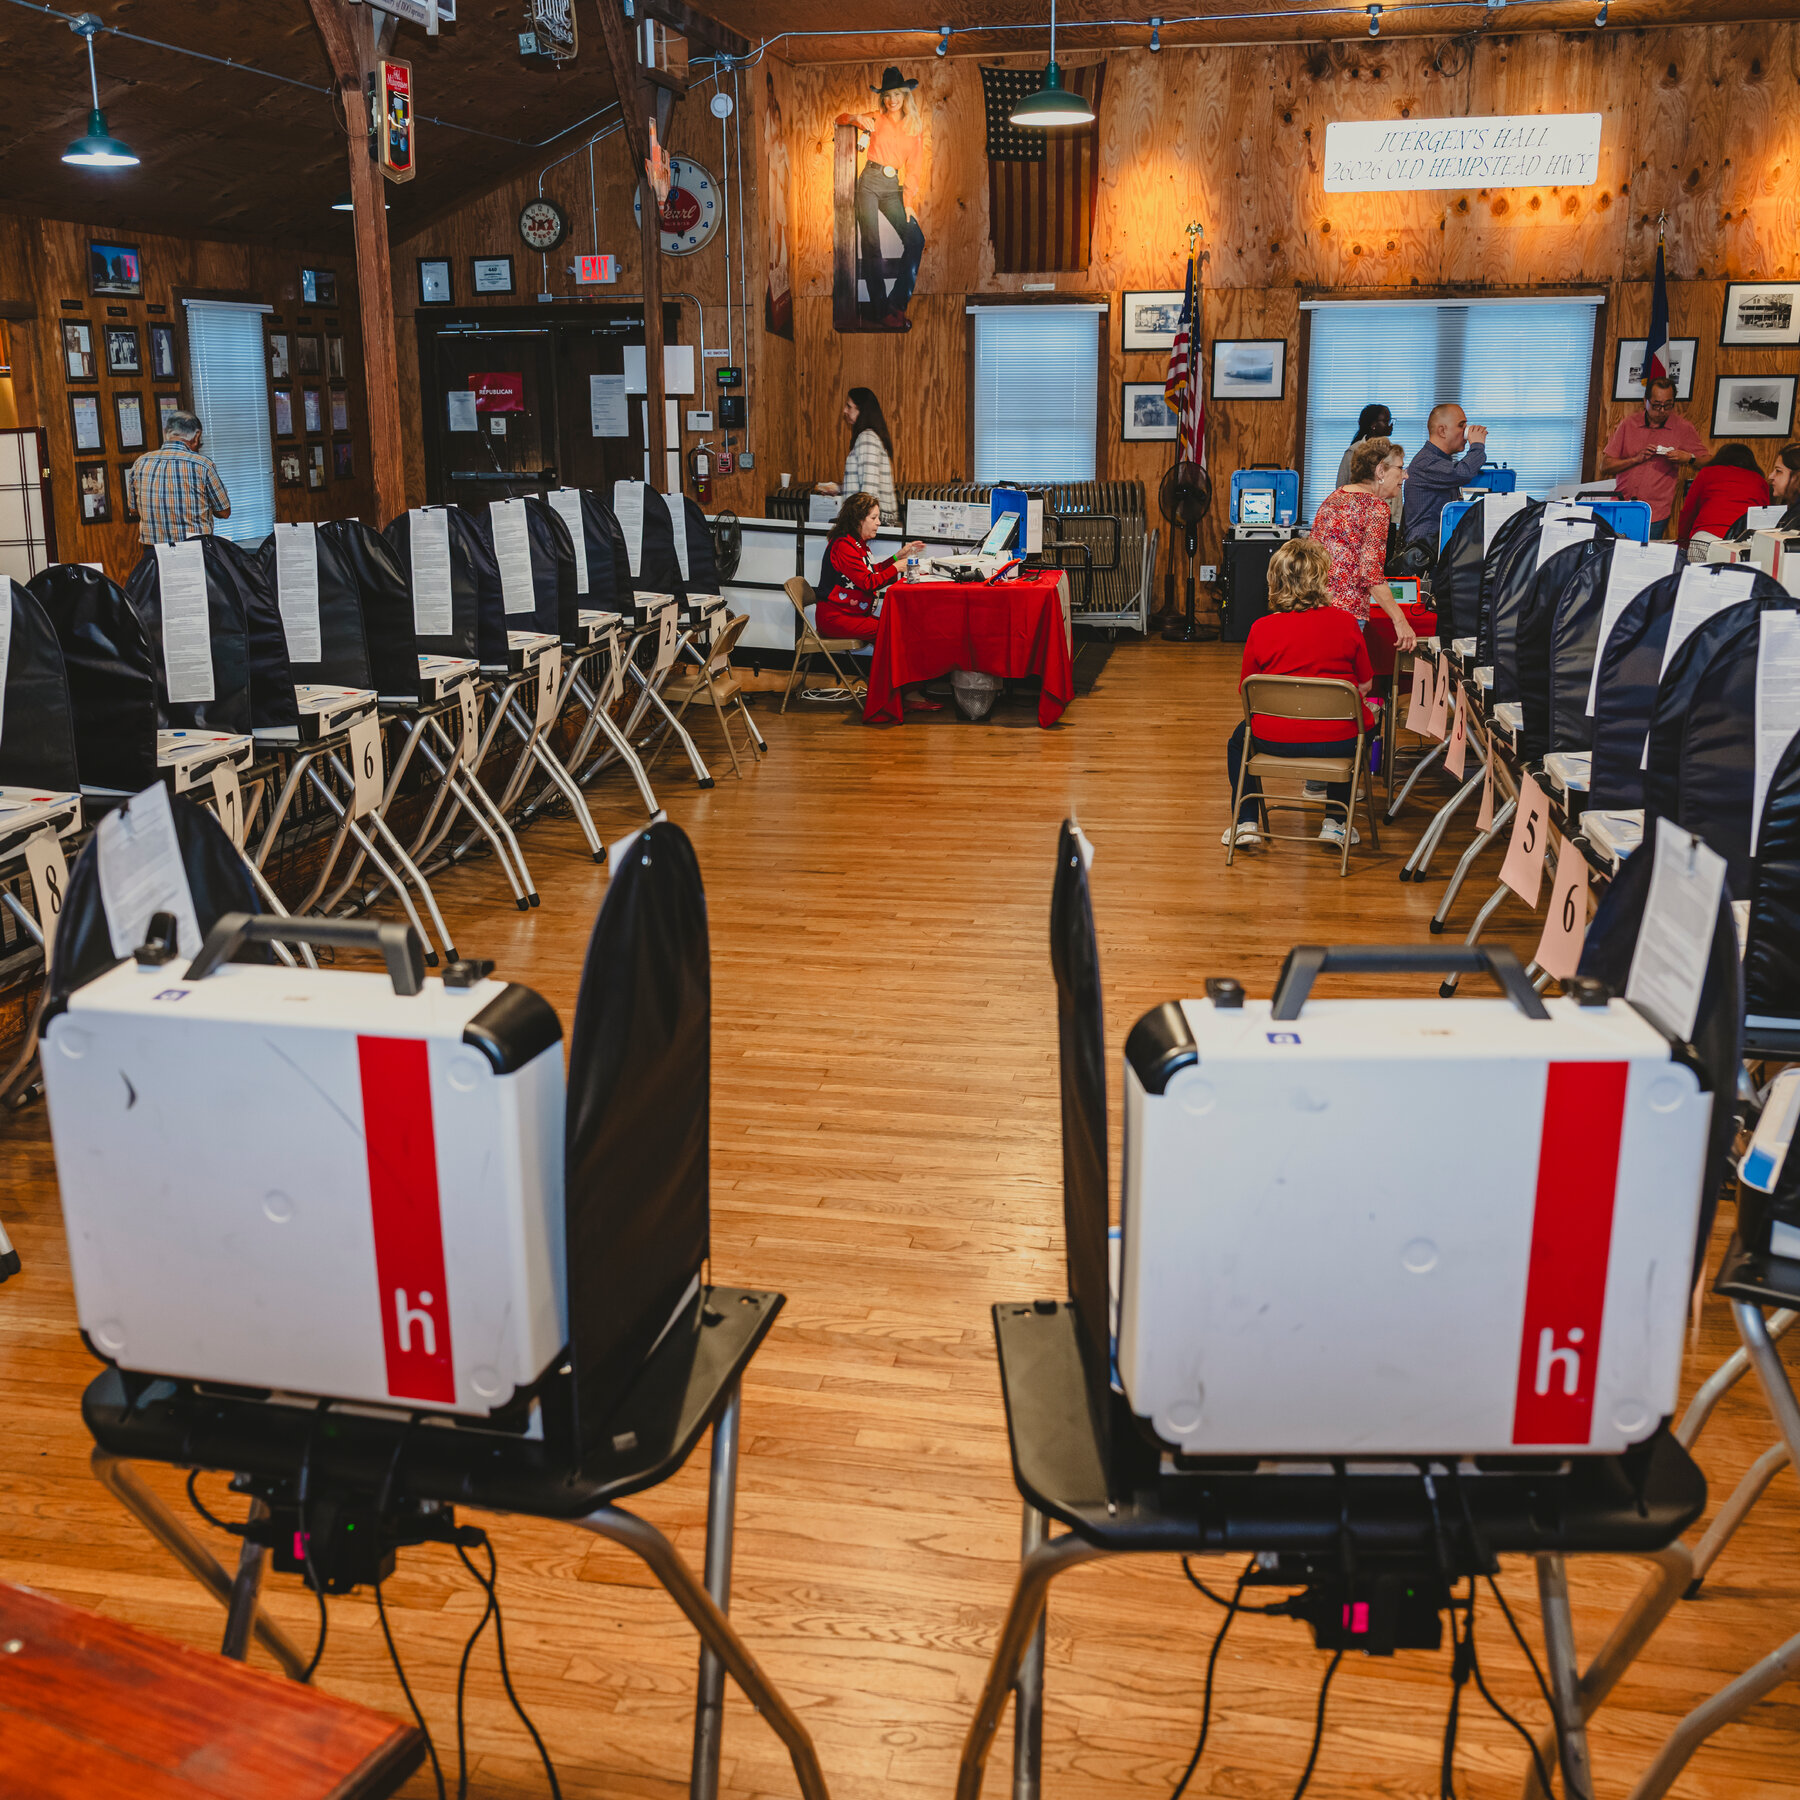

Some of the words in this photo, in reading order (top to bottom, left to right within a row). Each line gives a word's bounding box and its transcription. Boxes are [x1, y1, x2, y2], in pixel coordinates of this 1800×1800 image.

[1374, 128, 1489, 153] JUERGEN'S
[1493, 126, 1550, 148] HALL
[1328, 159, 1382, 181] 26026
[1386, 158, 1425, 180] OLD
[1428, 153, 1542, 178] HEMPSTEAD
[1545, 152, 1595, 176] HWY
[528, 219, 554, 231] JAX
[582, 256, 609, 281] EXIT
[665, 620, 671, 646] 2
[546, 666, 554, 694] 4
[1419, 678, 1425, 707] 1
[1439, 675, 1446, 707] 2
[468, 700, 474, 733] 5
[1457, 706, 1464, 741] 3
[364, 741, 374, 779] 6
[225, 790, 235, 842] 7
[1523, 809, 1539, 853] 5
[46, 864, 62, 914] 8
[1563, 884, 1579, 932] 6
[395, 1288, 436, 1355] hi
[1534, 1326, 1585, 1396] hi
